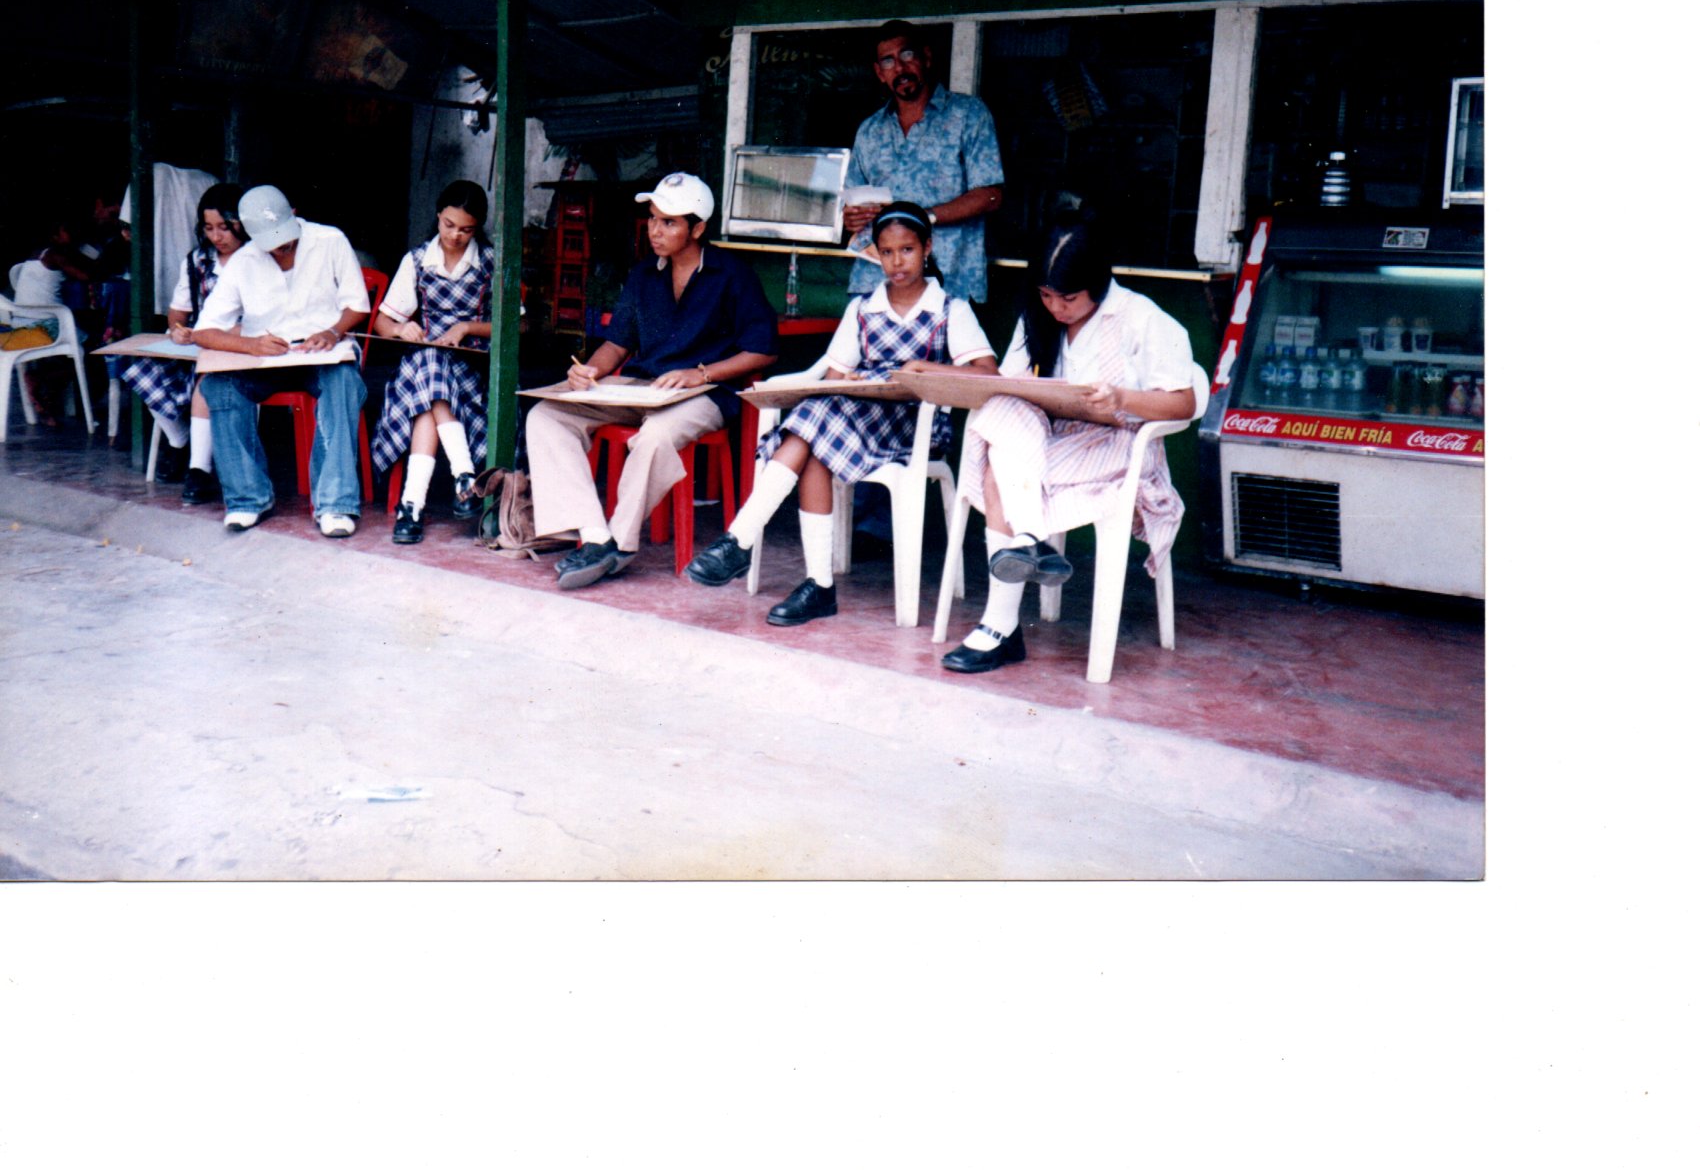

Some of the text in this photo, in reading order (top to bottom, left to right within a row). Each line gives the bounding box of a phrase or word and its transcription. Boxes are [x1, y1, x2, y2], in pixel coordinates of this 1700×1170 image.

[1281, 420, 1321, 436] AQUÍ
[1320, 425, 1355, 440] BIEN
[1357, 426, 1393, 444] FRÍA
